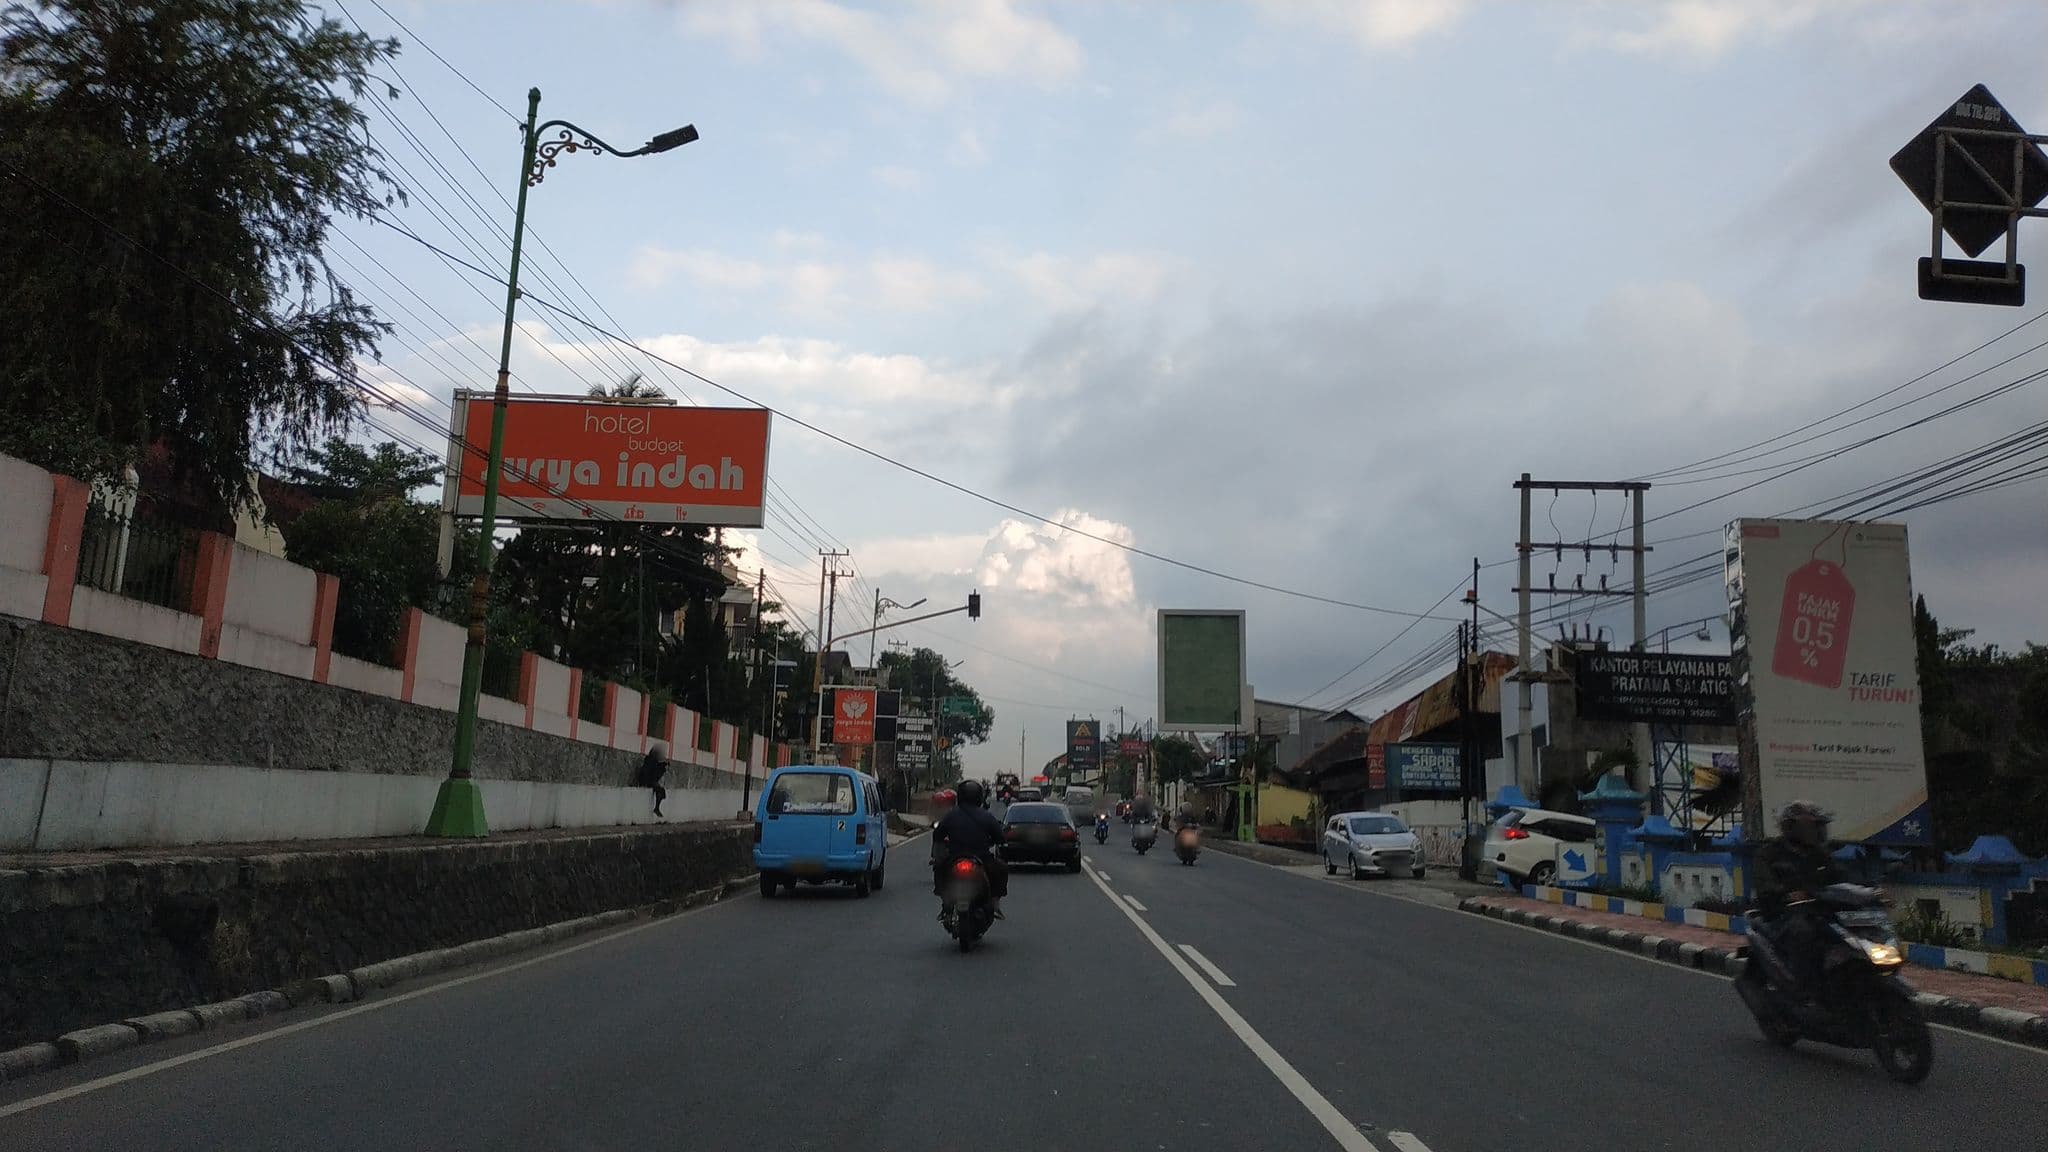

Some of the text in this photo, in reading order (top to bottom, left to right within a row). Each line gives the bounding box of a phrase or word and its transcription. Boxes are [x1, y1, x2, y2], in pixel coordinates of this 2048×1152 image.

[584, 409, 651, 435] hotel
[628, 436, 684, 455] budget
[481, 451, 744, 494] urya indah
[1798, 592, 1840, 613] PAJAK
[1590, 657, 1732, 677] KANTOR PELAYANAN PA
[1611, 676, 1728, 696] PRATAMA SALATIG
[1849, 672, 1897, 687] TARIF
[1848, 687, 1914, 704] TURUN!
[839, 791, 847, 801] 2
[839, 820, 845, 831] 2
